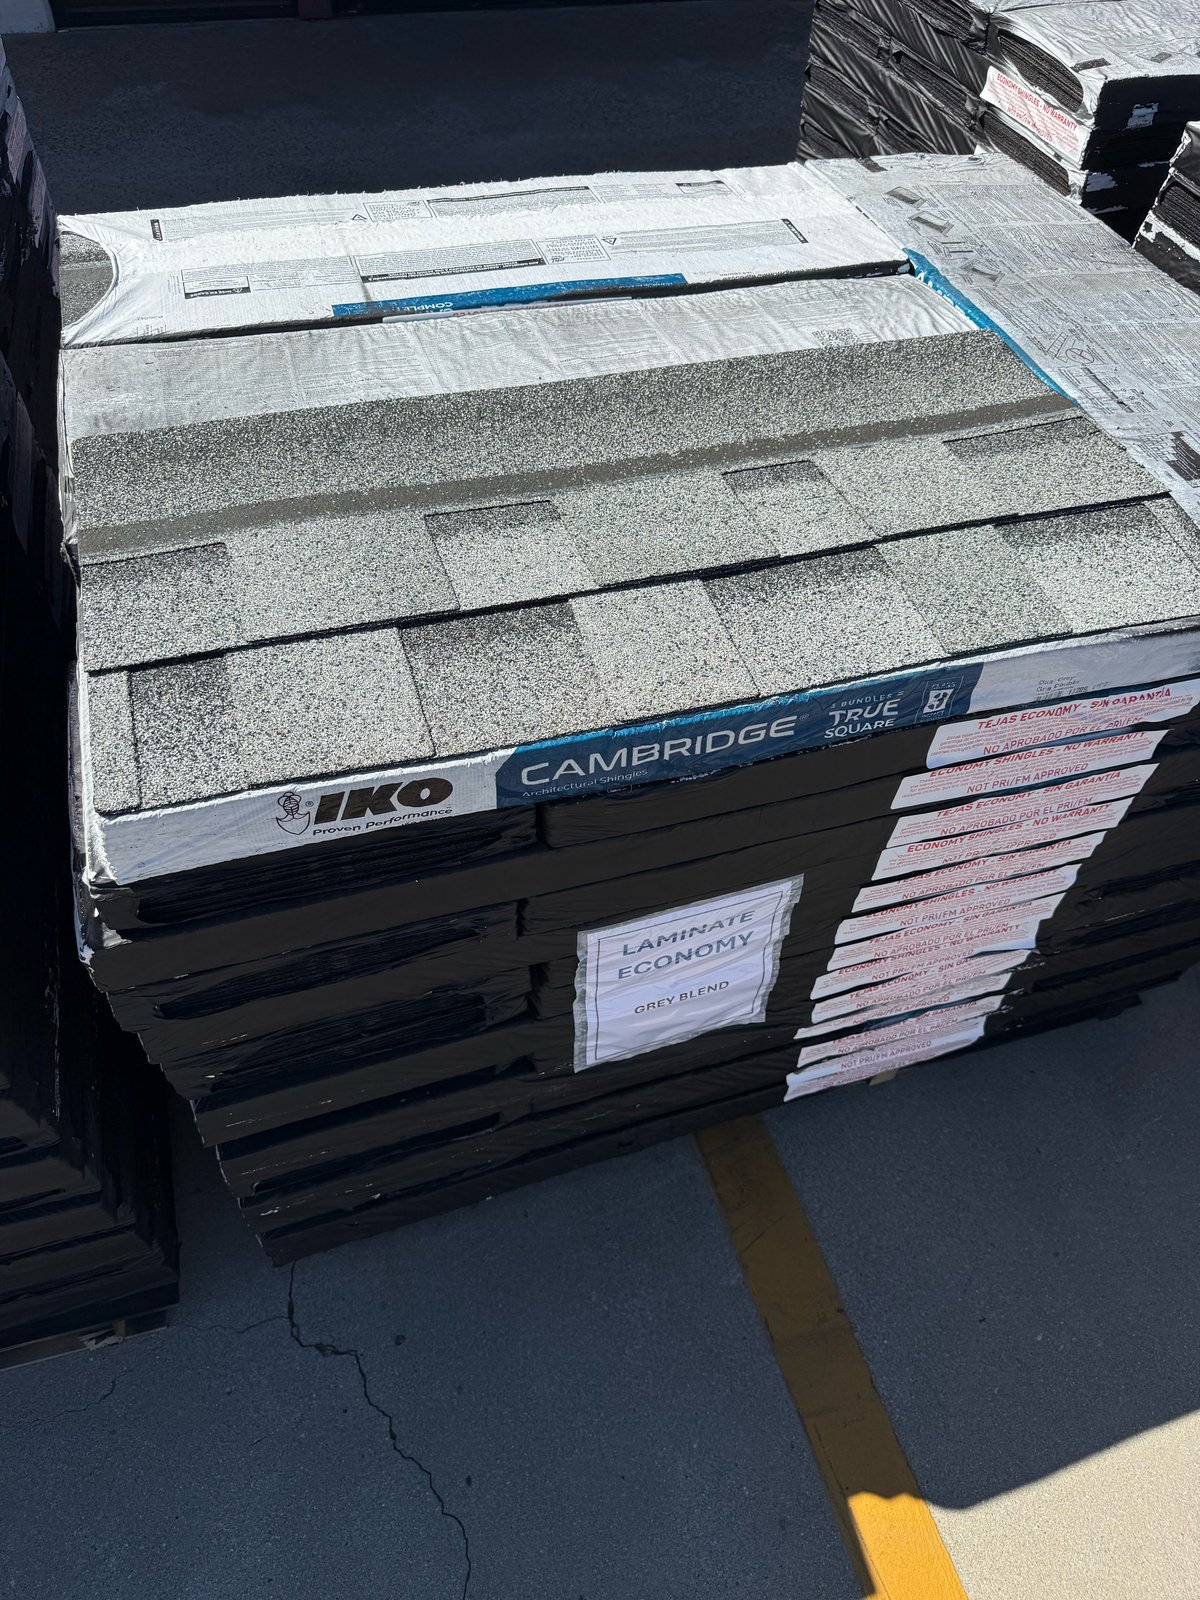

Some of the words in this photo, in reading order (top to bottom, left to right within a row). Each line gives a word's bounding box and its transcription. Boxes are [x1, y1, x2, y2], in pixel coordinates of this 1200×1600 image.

[997, 74, 1018, 91] ECONOMY
[1050, 109, 1077, 130] WARRANTY
[829, 699, 901, 726] TRUE
[841, 693, 891, 706] BUNDLES
[824, 718, 896, 738] SQUARE
[978, 714, 1016, 730] TEJAS
[1020, 703, 1079, 721] ECONOMY
[521, 715, 798, 785] CAMBRIDGE
[983, 745, 1001, 755] NO
[1003, 730, 1062, 751] APROBADO
[1064, 726, 1087, 737] POR
[930, 759, 993, 777] ECONOMY
[995, 747, 1053, 765] SHINGLES
[522, 778, 598, 797] Architectural
[599, 769, 648, 784] Shingles
[967, 781, 988, 793] NOT
[991, 775, 1030, 788] PRI/FM
[1033, 763, 1088, 781] APPROVED
[314, 777, 454, 825] IKO
[936, 804, 973, 817] TEJAS
[976, 792, 1032, 809] ECONOMY
[1043, 784, 1063, 795] SIN
[313, 824, 361, 836] Proven
[365, 807, 453, 830] Performance
[907, 836, 965, 852] ECONOMY
[967, 823, 1023, 839] SHINGLES
[1033, 816, 1048, 825] NO
[1051, 803, 1111, 823] WARRANTY
[940, 825, 957, 835] NO
[959, 813, 1016, 832] APROBADO
[1019, 809, 1040, 819] POR
[1043, 806, 1055, 816] EL
[1056, 797, 1092, 811] PRI/FM
[997, 852, 1017, 862] SIN
[902, 891, 916, 899] NO
[975, 873, 995, 882] POR
[921, 889, 975, 906] SHINGLES
[900, 916, 919, 926] NOT
[922, 908, 956, 921] PRI/FM
[959, 899, 1010, 914] APPROVED
[904, 923, 952, 938] ECONOMY
[964, 915, 980, 923] SIN
[623, 910, 755, 956] LAMINATE
[890, 938, 940, 954] APROBADO
[977, 923, 1008, 934] PRI/FM
[618, 931, 753, 979] ECONOMY
[839, 957, 890, 974] ECONOMY
[938, 963, 954, 971] SIN
[634, 996, 676, 1014] GREY
[679, 981, 729, 1001] BLEND
[856, 1000, 869, 1008] NO
[841, 1059, 857, 1069] NOT
[859, 1051, 888, 1065] PRI/FM
[889, 1041, 932, 1056] APPROVED
